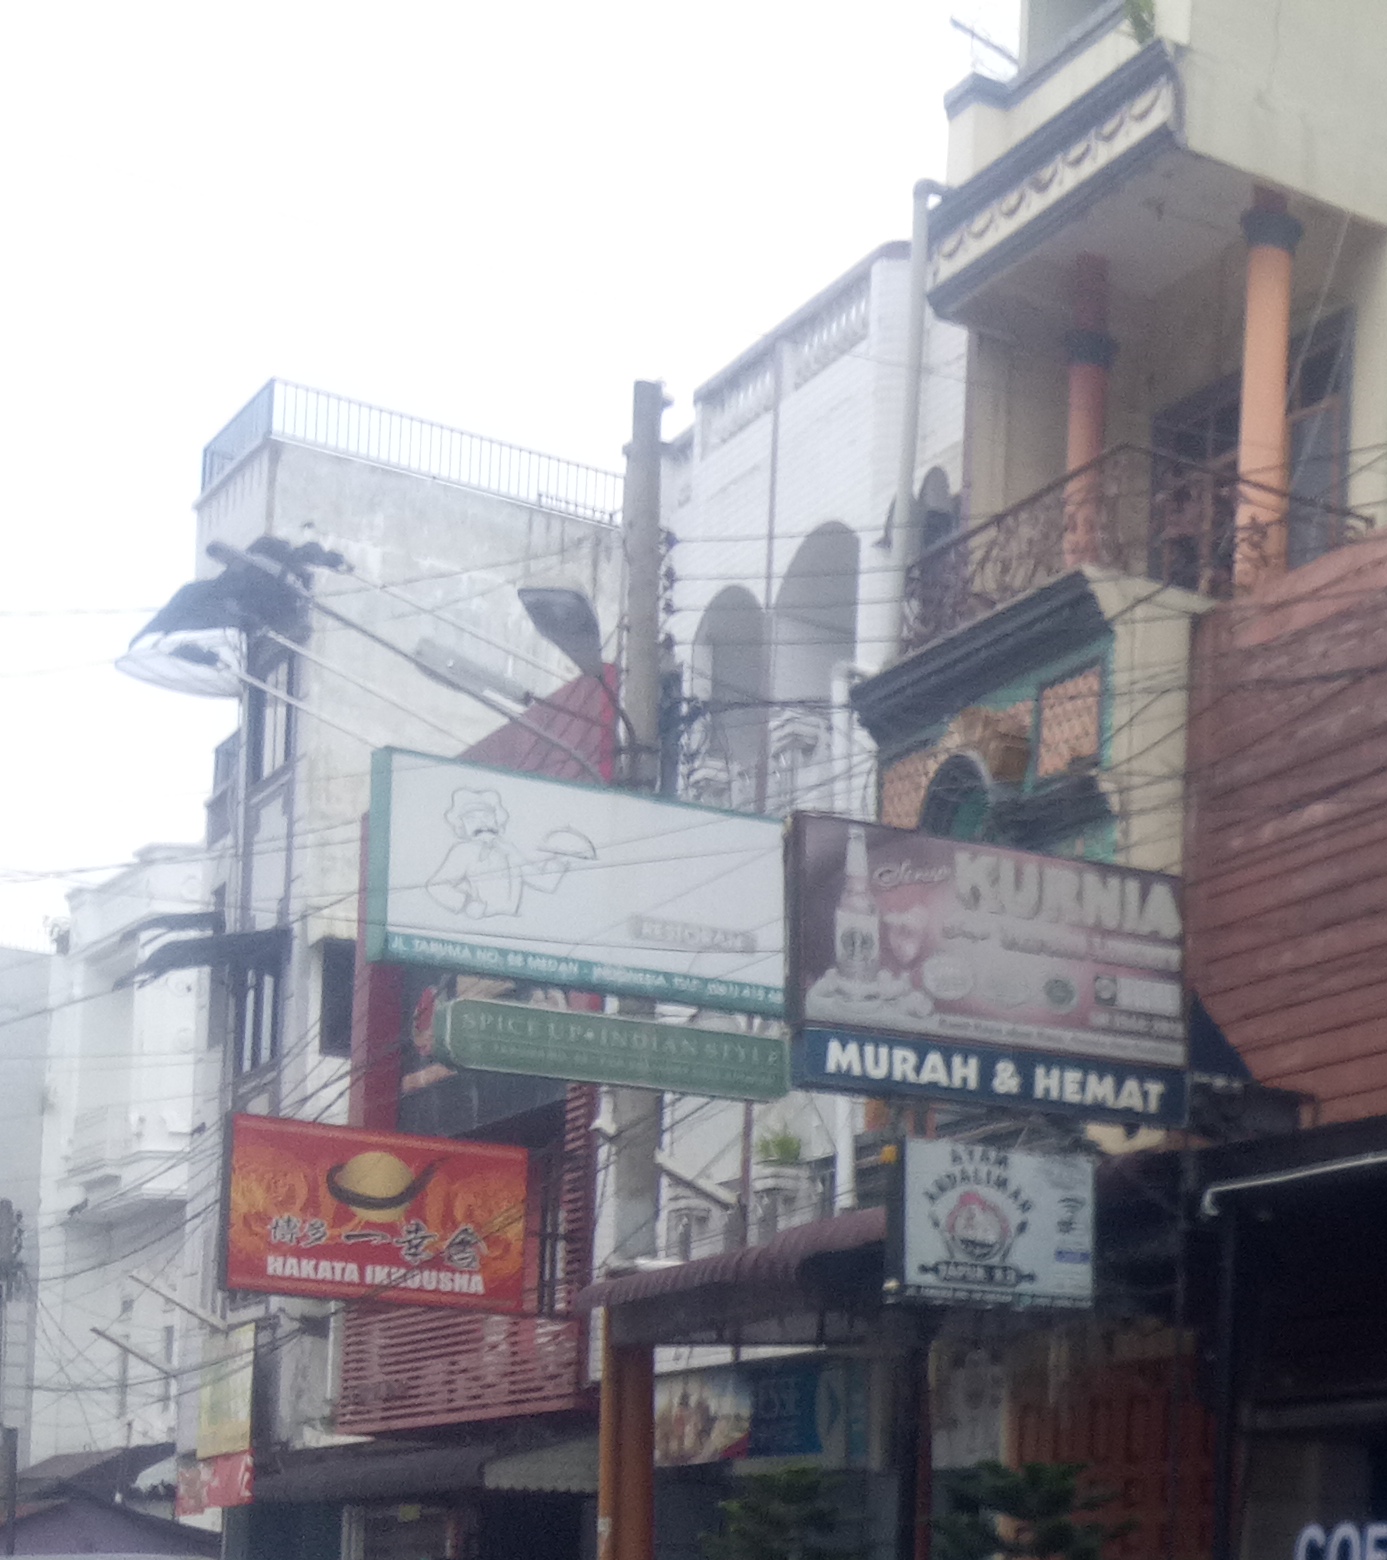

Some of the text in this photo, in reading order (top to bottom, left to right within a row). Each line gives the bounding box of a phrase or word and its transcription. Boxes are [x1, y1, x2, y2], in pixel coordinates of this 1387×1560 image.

[954, 852, 1182, 939] KURNIA
[527, 954, 580, 974] MEDAN
[825, 1038, 979, 1091] MURAH
[991, 1059, 1021, 1096] &
[1033, 1064, 1166, 1114] HEMAT
[267, 1255, 360, 1284] HAKATA
